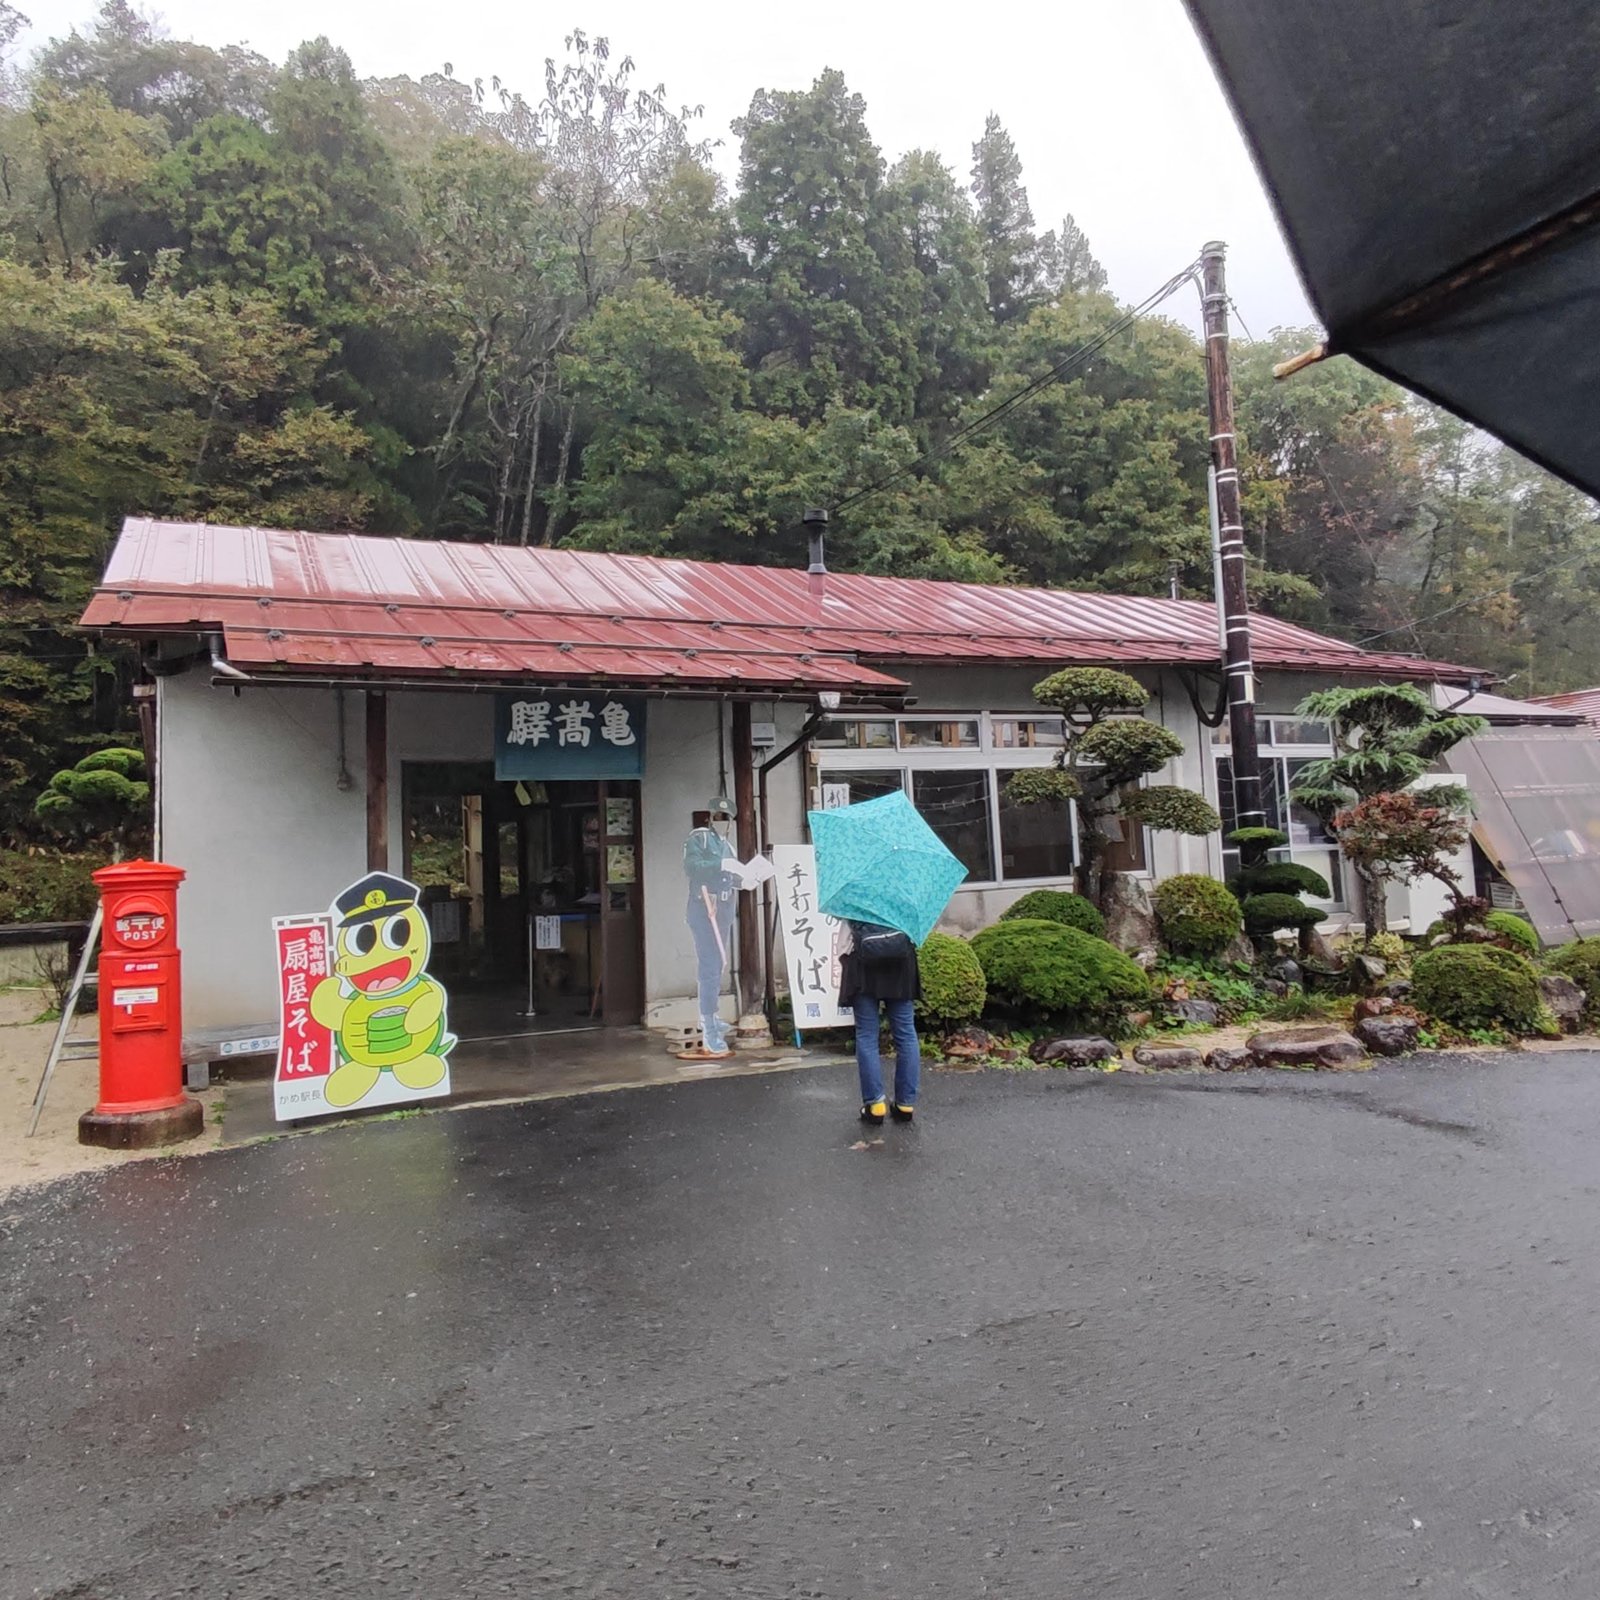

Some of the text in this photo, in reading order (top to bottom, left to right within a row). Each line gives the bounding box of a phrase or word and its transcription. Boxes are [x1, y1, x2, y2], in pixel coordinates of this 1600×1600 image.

[123, 931, 157, 941] POST
[787, 863, 828, 996] 手打そば
[283, 938, 318, 1074] 扇屋そば
[279, 1090, 321, 1105] かめ駅長
